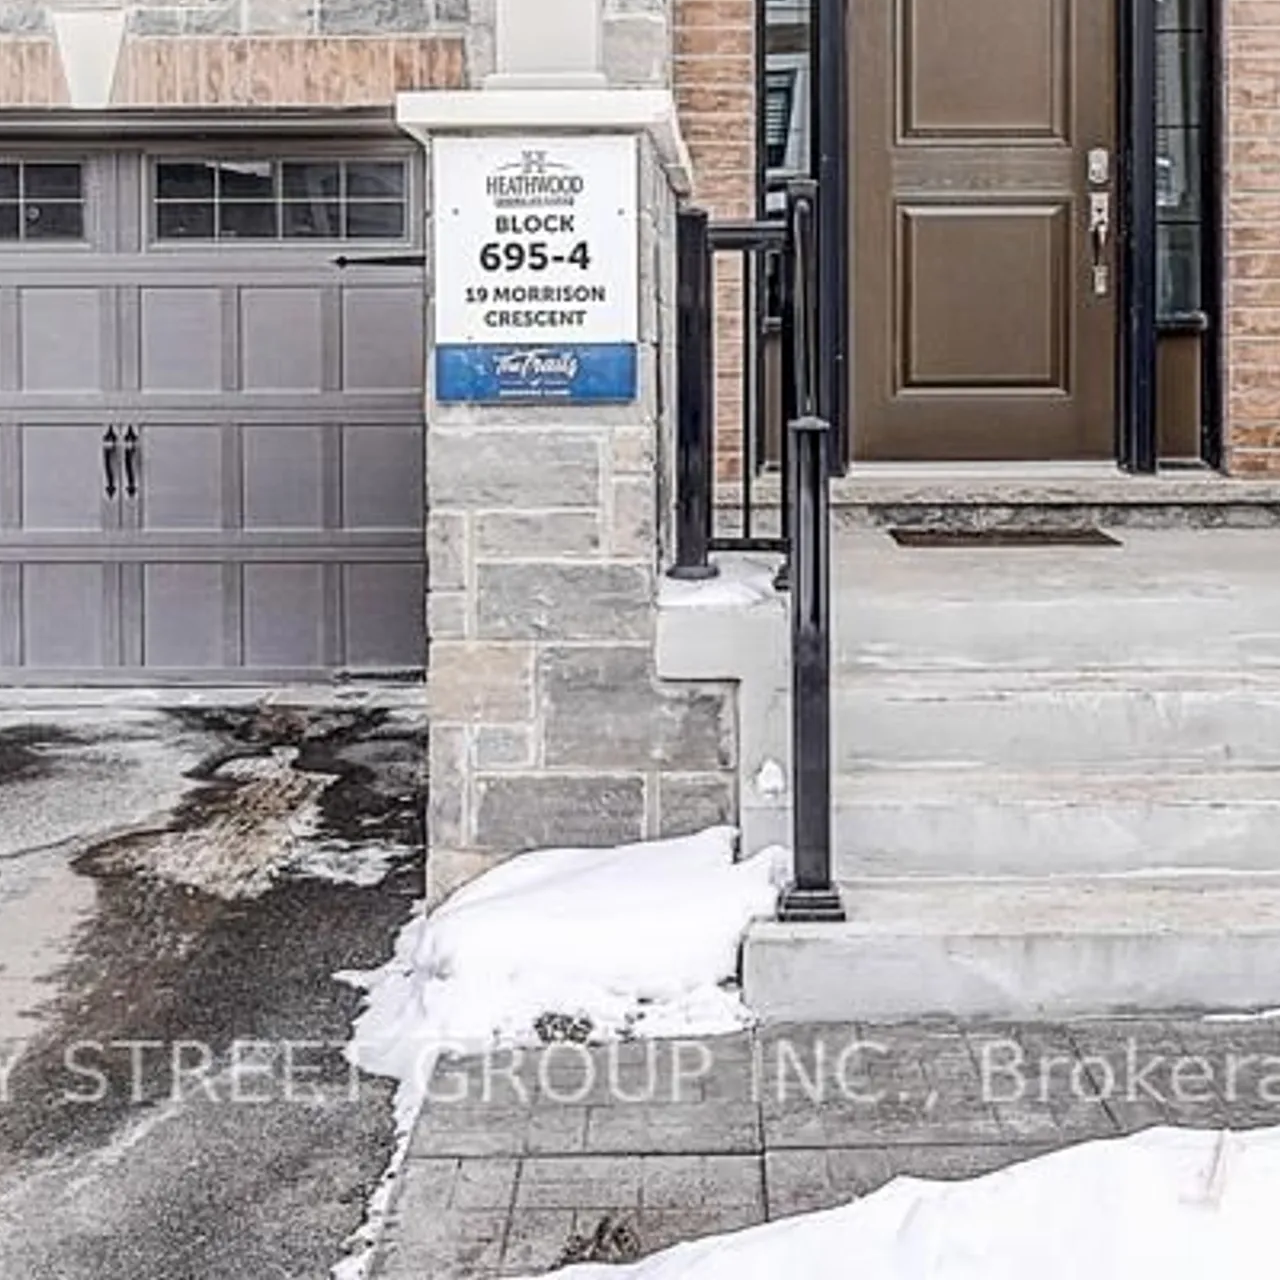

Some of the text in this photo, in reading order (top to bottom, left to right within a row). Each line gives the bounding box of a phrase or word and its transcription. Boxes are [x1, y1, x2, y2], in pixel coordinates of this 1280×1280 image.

[486, 175, 584, 195] HEATHWOOD
[495, 214, 574, 233] BLOCK
[479, 241, 590, 271] 695-4
[465, 285, 605, 302] 19 MORRISON
[483, 309, 587, 328] CRESCENT
